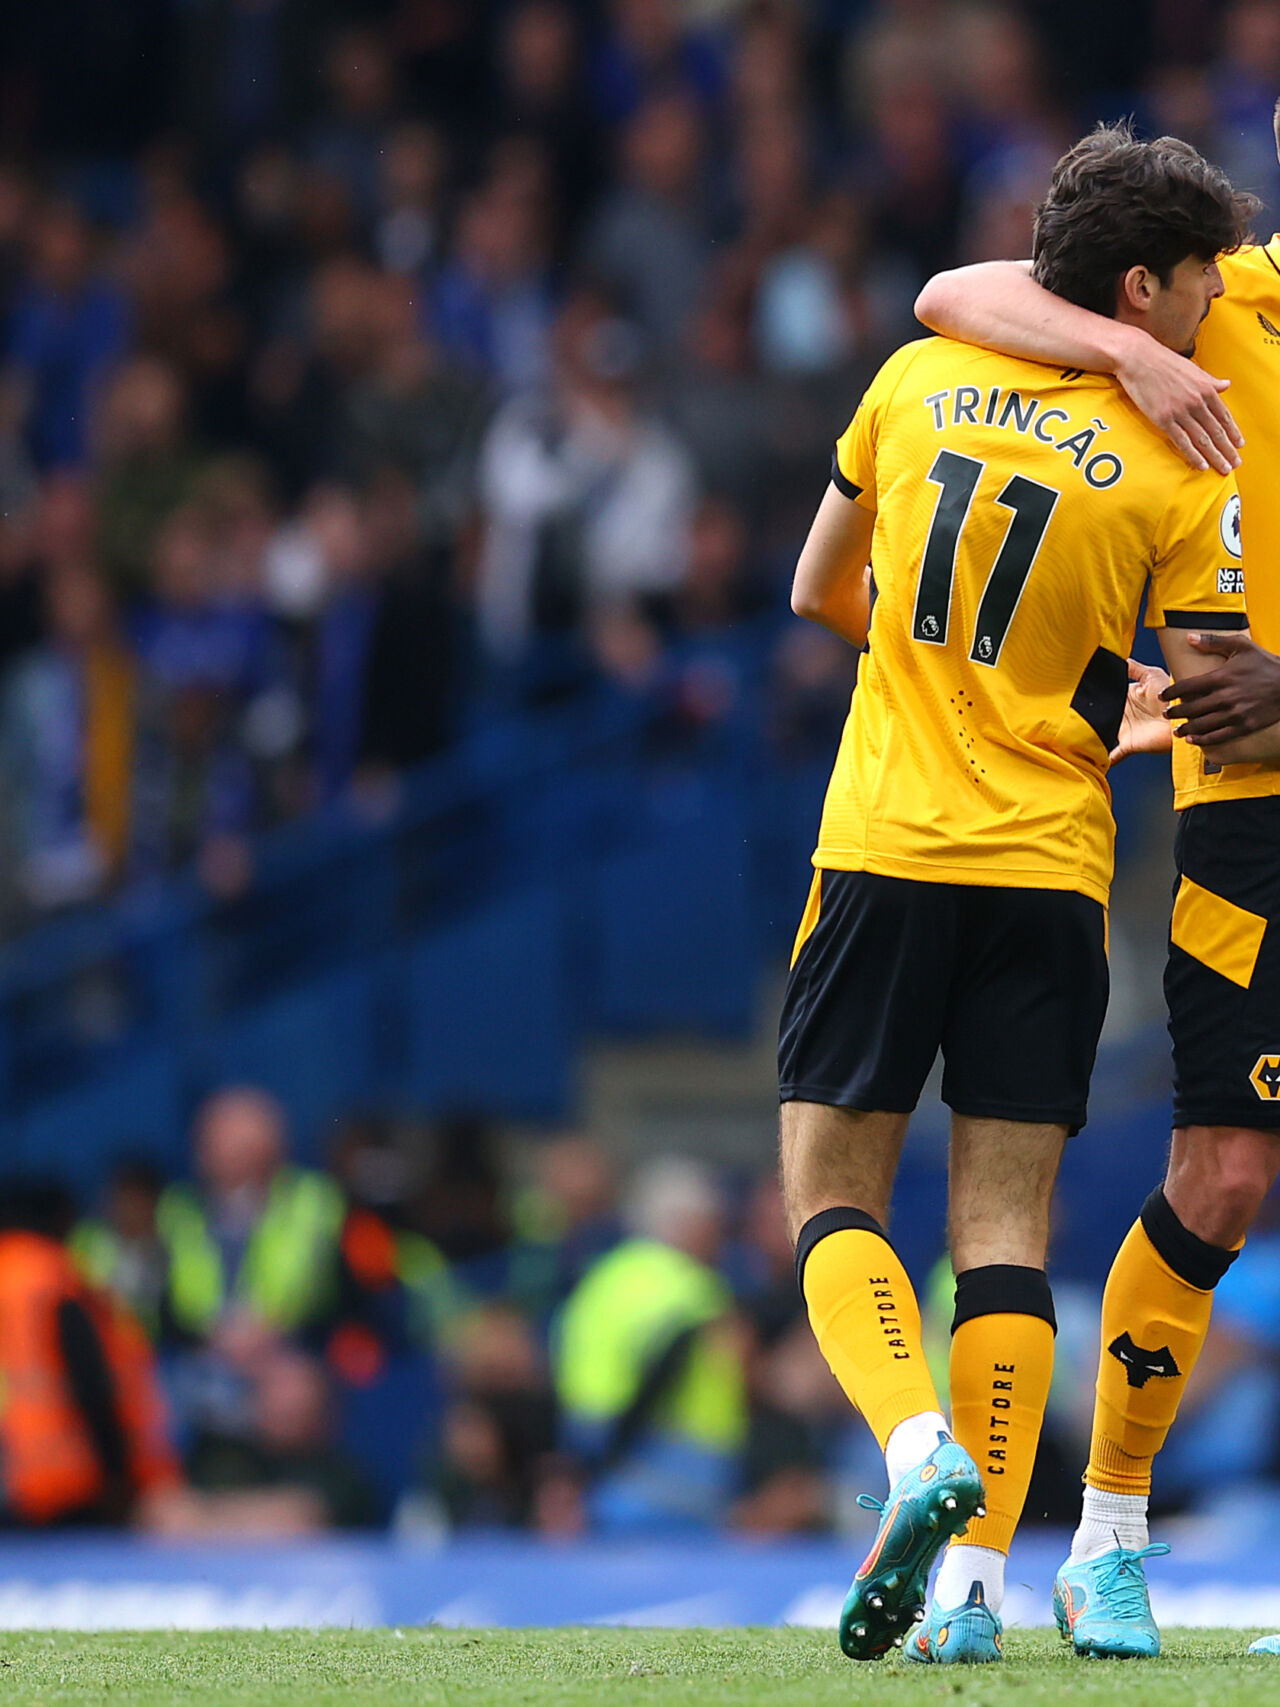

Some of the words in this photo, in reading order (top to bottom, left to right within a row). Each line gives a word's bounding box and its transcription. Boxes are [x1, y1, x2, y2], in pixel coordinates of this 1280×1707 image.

[924, 385, 1125, 490] TRINCÃO
[911, 448, 1062, 668] 11
[869, 1276, 910, 1360] CASTORE
[987, 1363, 1015, 1475] CASTORE
